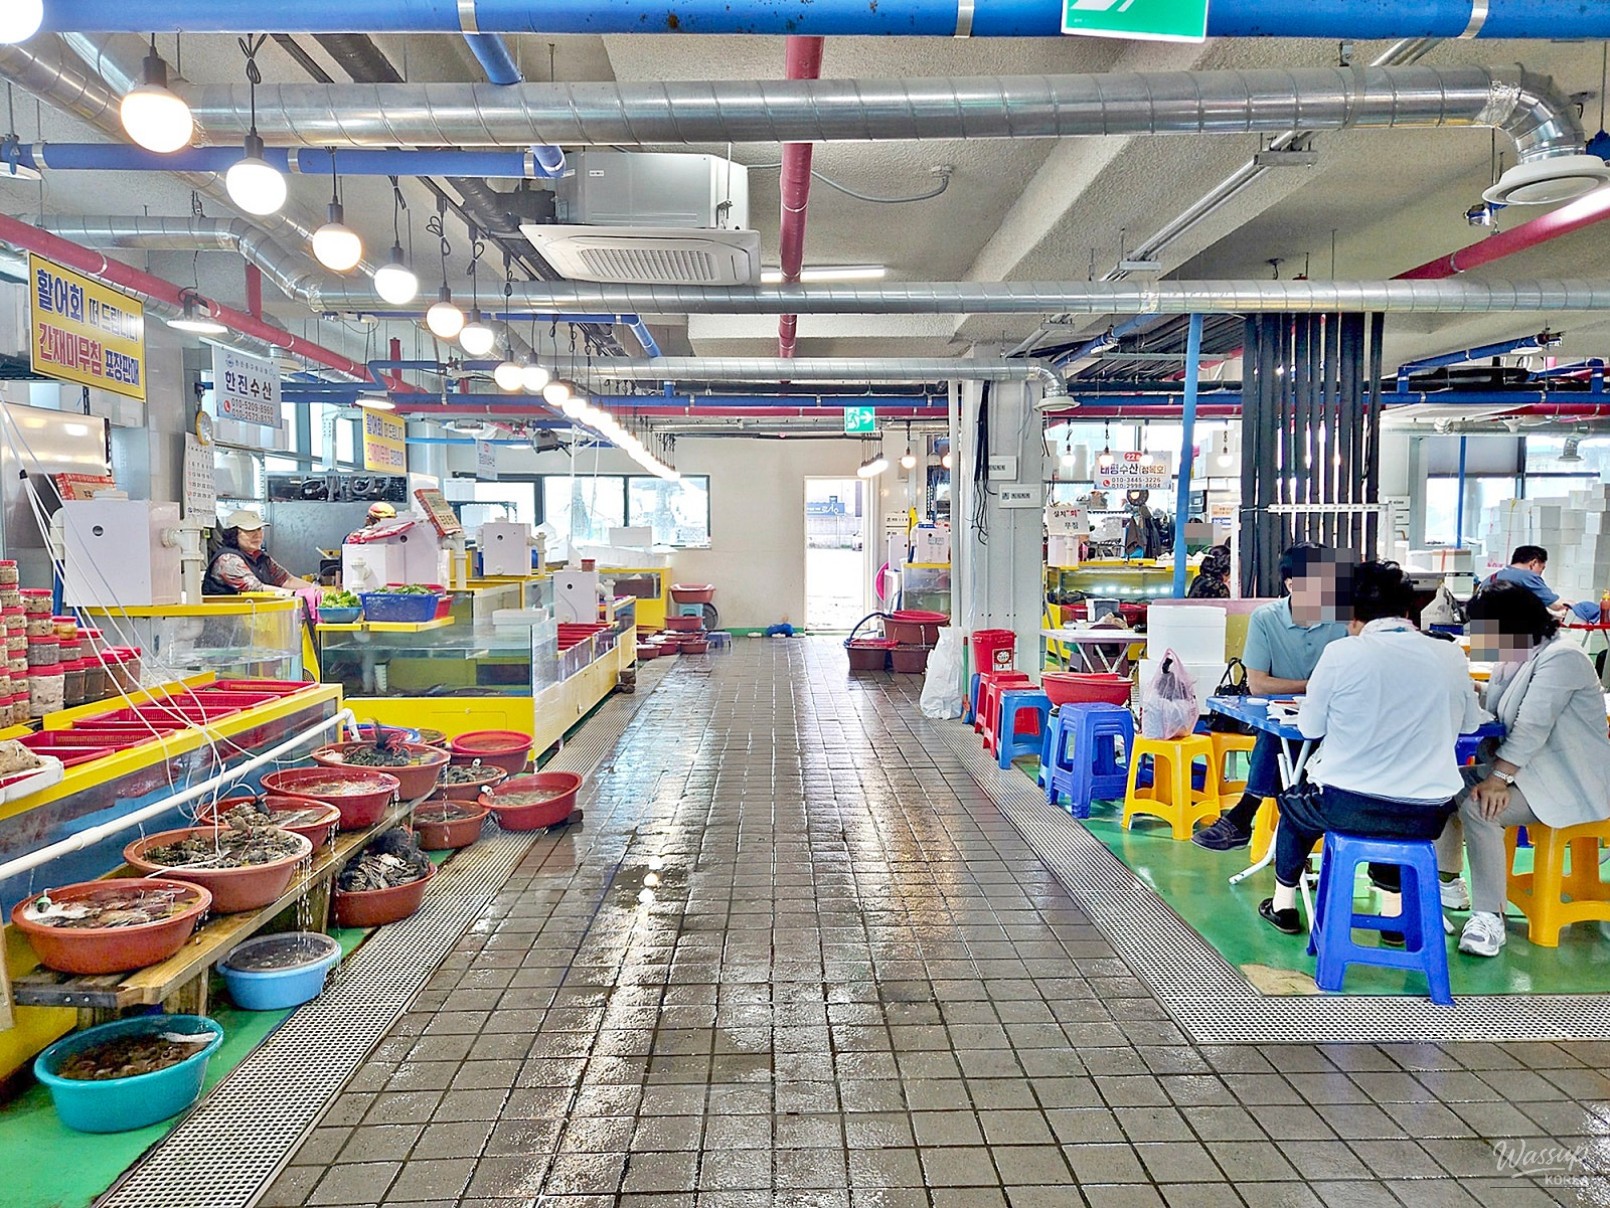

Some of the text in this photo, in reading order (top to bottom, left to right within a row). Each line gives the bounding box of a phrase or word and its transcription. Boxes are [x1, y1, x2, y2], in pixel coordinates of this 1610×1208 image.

[36, 269, 84, 324] 활어회
[88, 297, 100, 327] 떠
[39, 322, 140, 386] 간재미무침 포장판매
[225, 370, 272, 401] 한진수산
